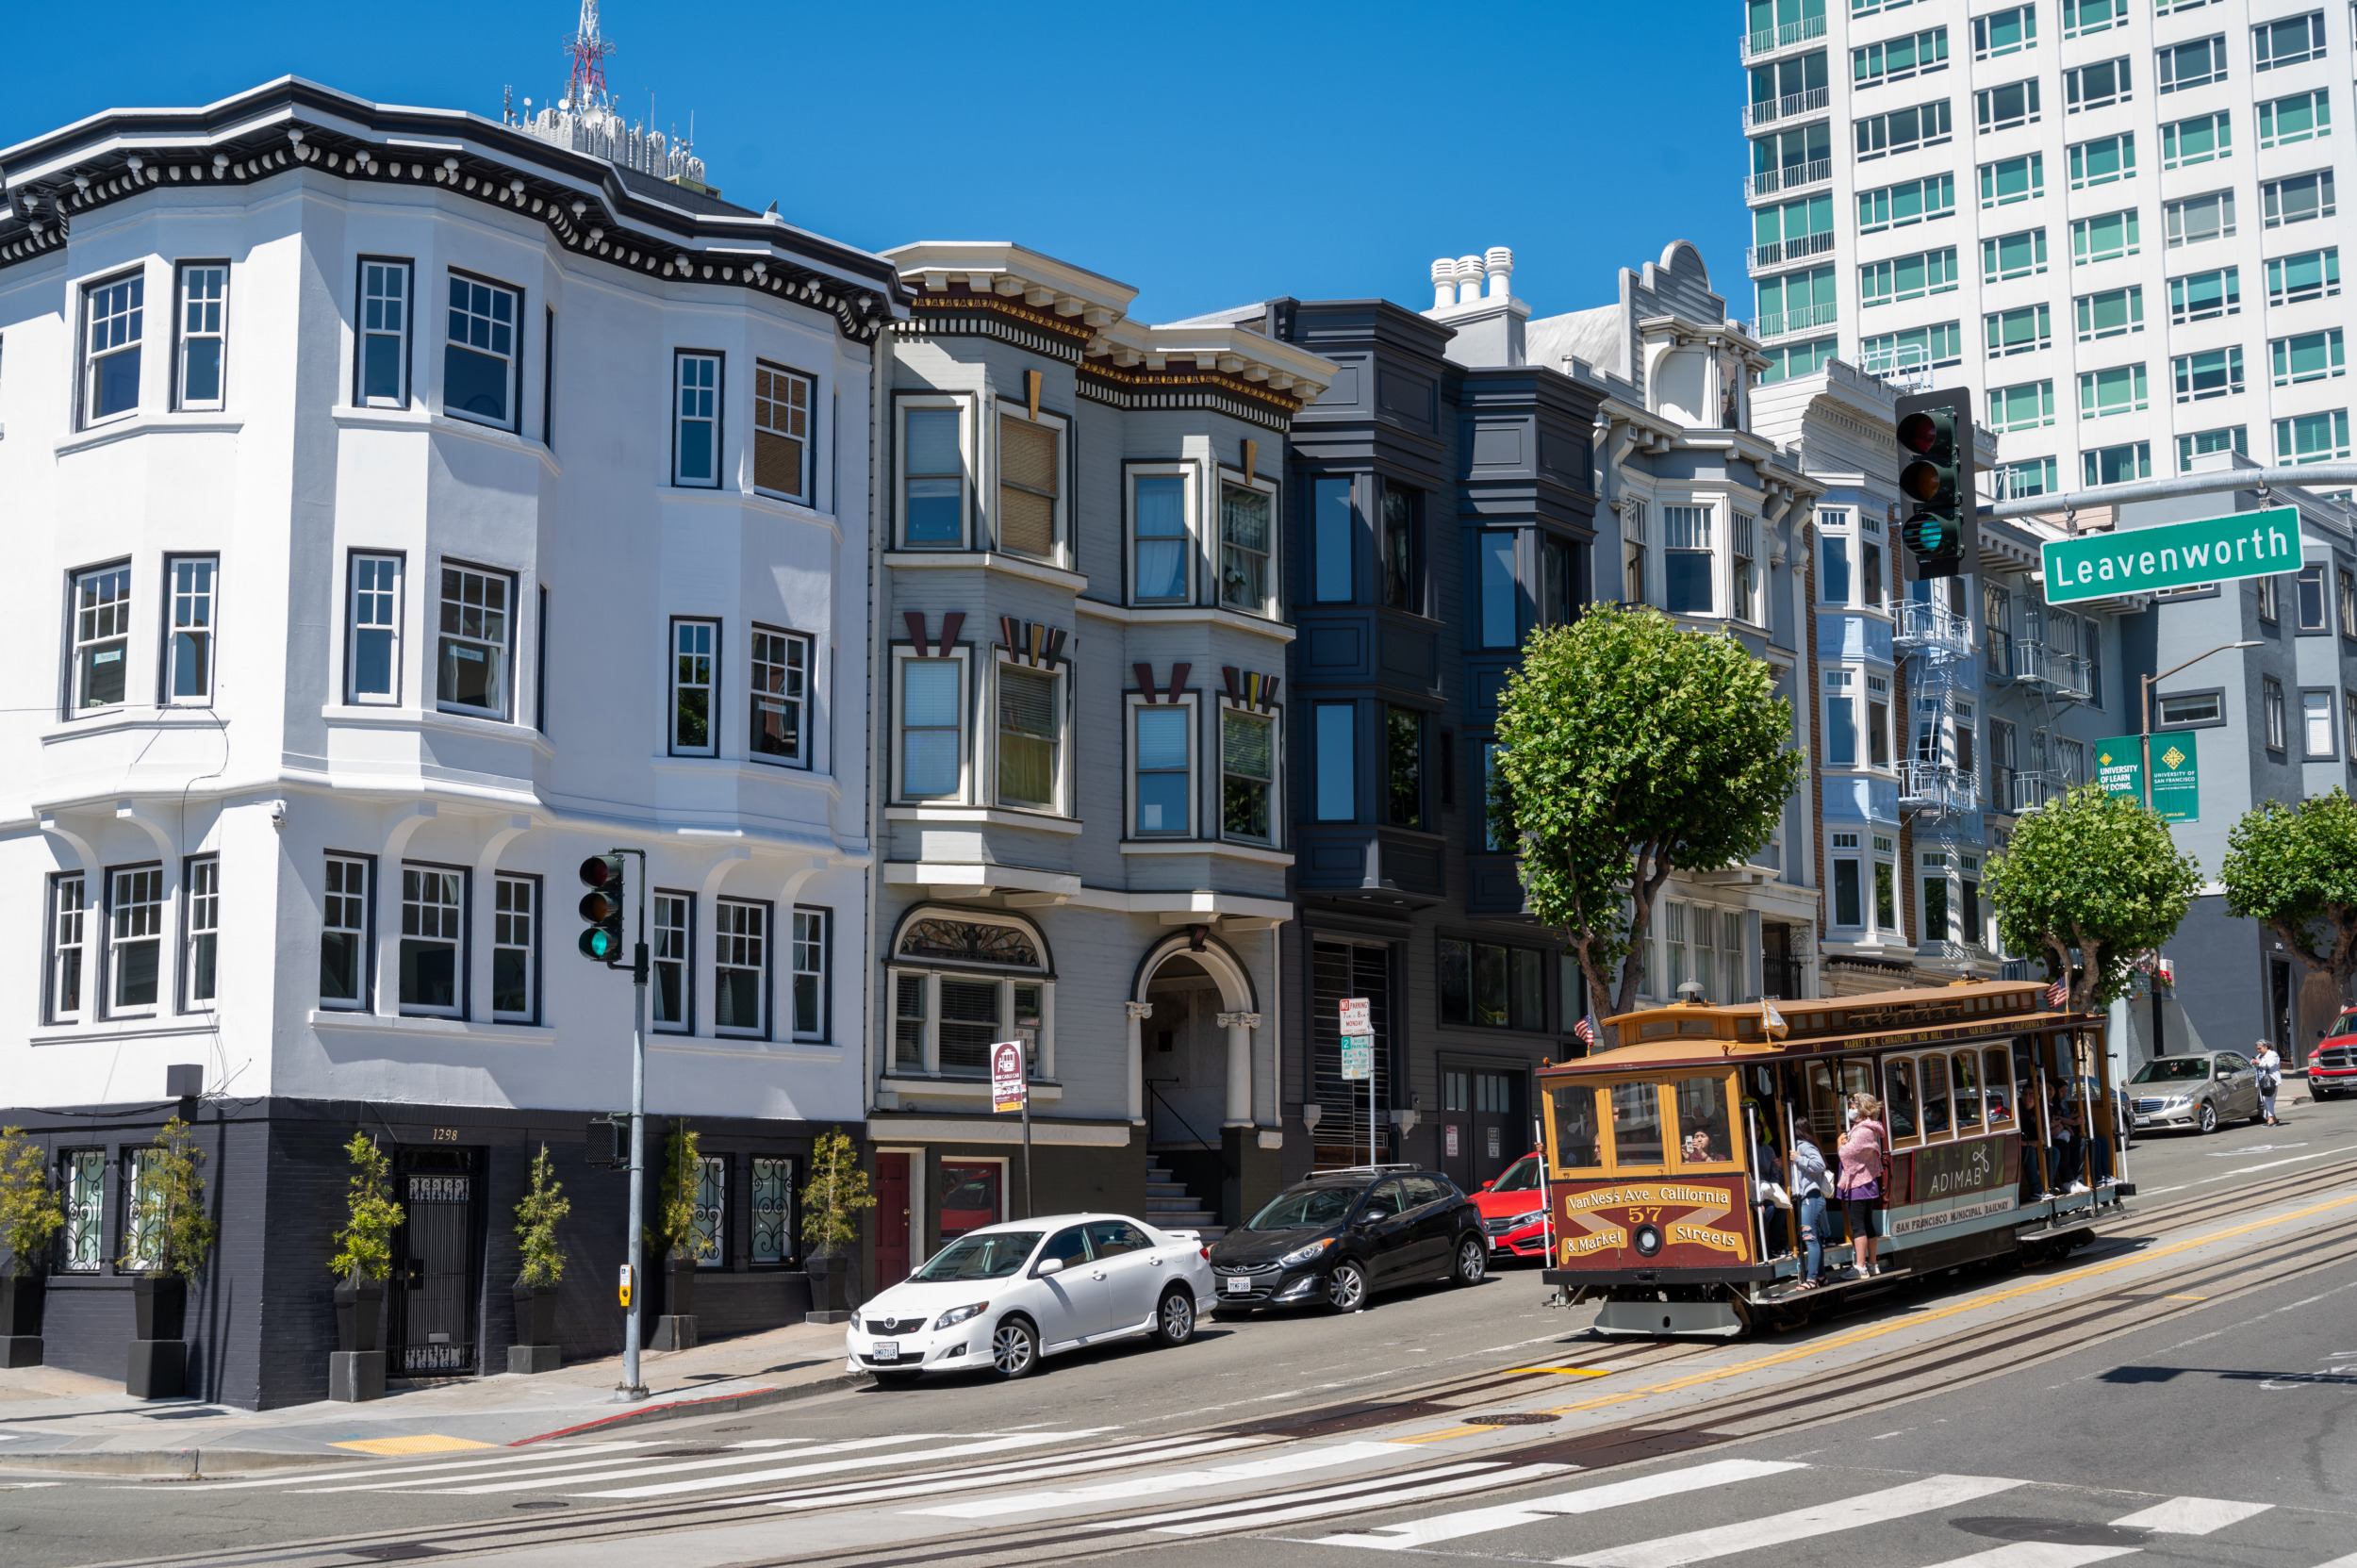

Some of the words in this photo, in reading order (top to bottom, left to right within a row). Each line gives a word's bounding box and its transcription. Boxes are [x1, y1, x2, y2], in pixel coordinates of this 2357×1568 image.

[2056, 525, 2288, 587] Leavenworth
[2100, 765, 2138, 775] UNIVERSITY
[2110, 774, 2131, 783] LEARN
[2110, 783, 2133, 791] DOING.
[1342, 1000, 1349, 1011] NO
[1843, 1038, 1866, 1049] MARKET
[1881, 1034, 1912, 1046] CHINATOWN
[1917, 1032, 1928, 1041] NOB
[1930, 1031, 1943, 1040] HILL
[2010, 1019, 2040, 1031] CALIFORNIA
[1343, 1039, 1349, 1048] 2
[433, 1129, 458, 1141] 1298
[1930, 1167, 1982, 1194] ADIMAB
[1659, 1187, 1729, 1204] California
[1628, 1207, 1662, 1224] 57
[1896, 1222, 1910, 1233] SAN
[1911, 1213, 1948, 1230] FRANCISCO
[1950, 1206, 1983, 1222] MUNICIPAL
[1985, 1200, 2009, 1214] RAILWAY
[1568, 1240, 1577, 1253] &
[1578, 1230, 1623, 1251] Market
[1675, 1226, 1736, 1246] Streets
